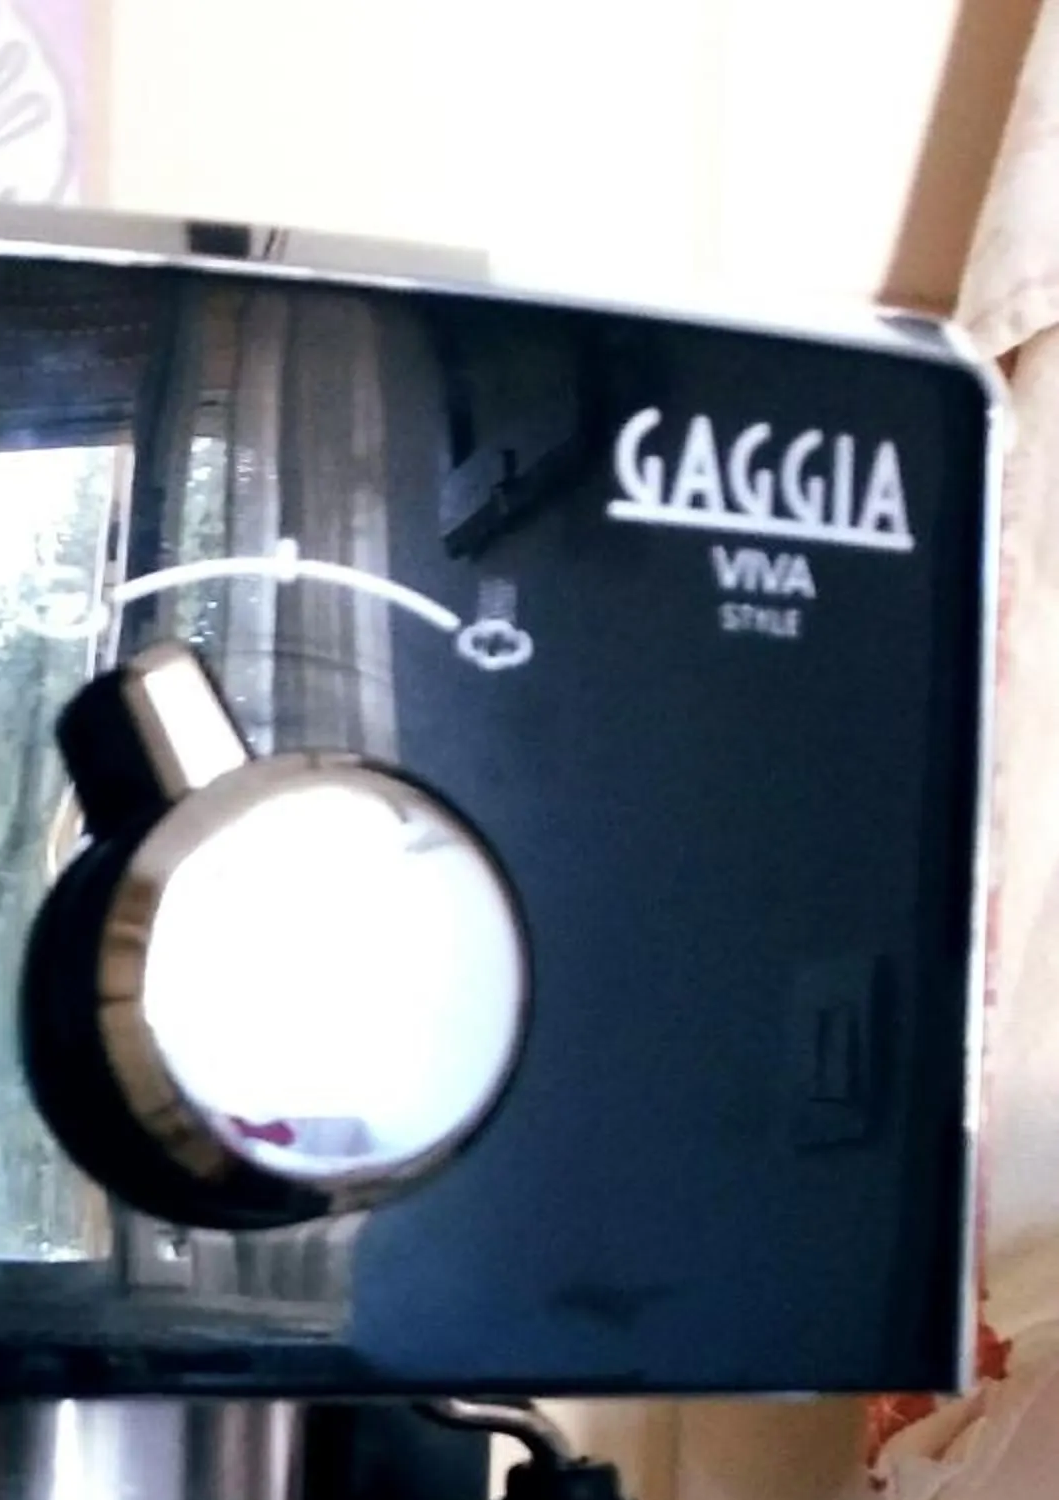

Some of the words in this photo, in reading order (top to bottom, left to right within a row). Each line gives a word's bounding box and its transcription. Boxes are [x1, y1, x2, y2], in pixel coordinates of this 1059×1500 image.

[611, 406, 914, 546] GAGGIA
[710, 545, 816, 599] VIVA
[719, 603, 801, 638] STYLE
